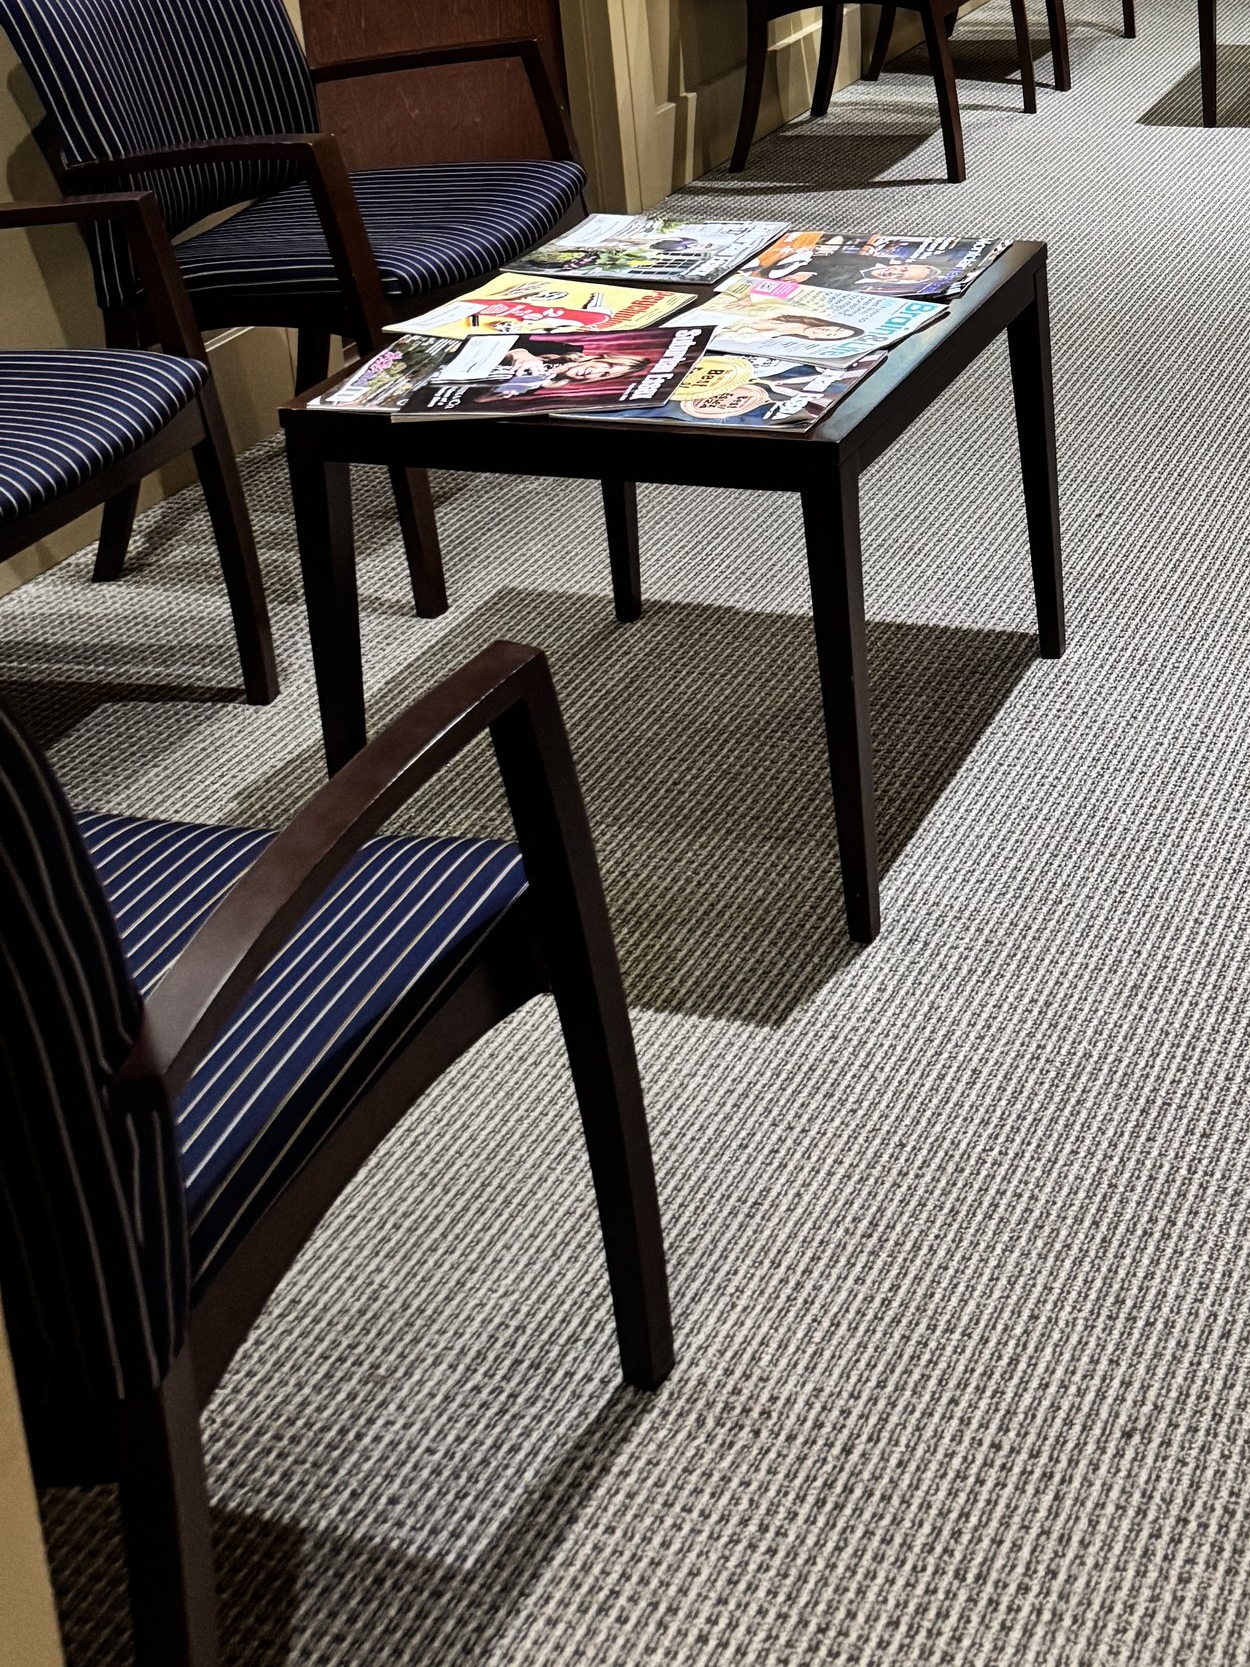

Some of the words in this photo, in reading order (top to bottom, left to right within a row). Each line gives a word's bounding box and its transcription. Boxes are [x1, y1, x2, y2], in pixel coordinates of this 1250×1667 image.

[649, 328, 702, 374] Suburban
[629, 373, 675, 401] Essex
[691, 368, 726, 387] Best
[727, 395, 749, 409] Best
